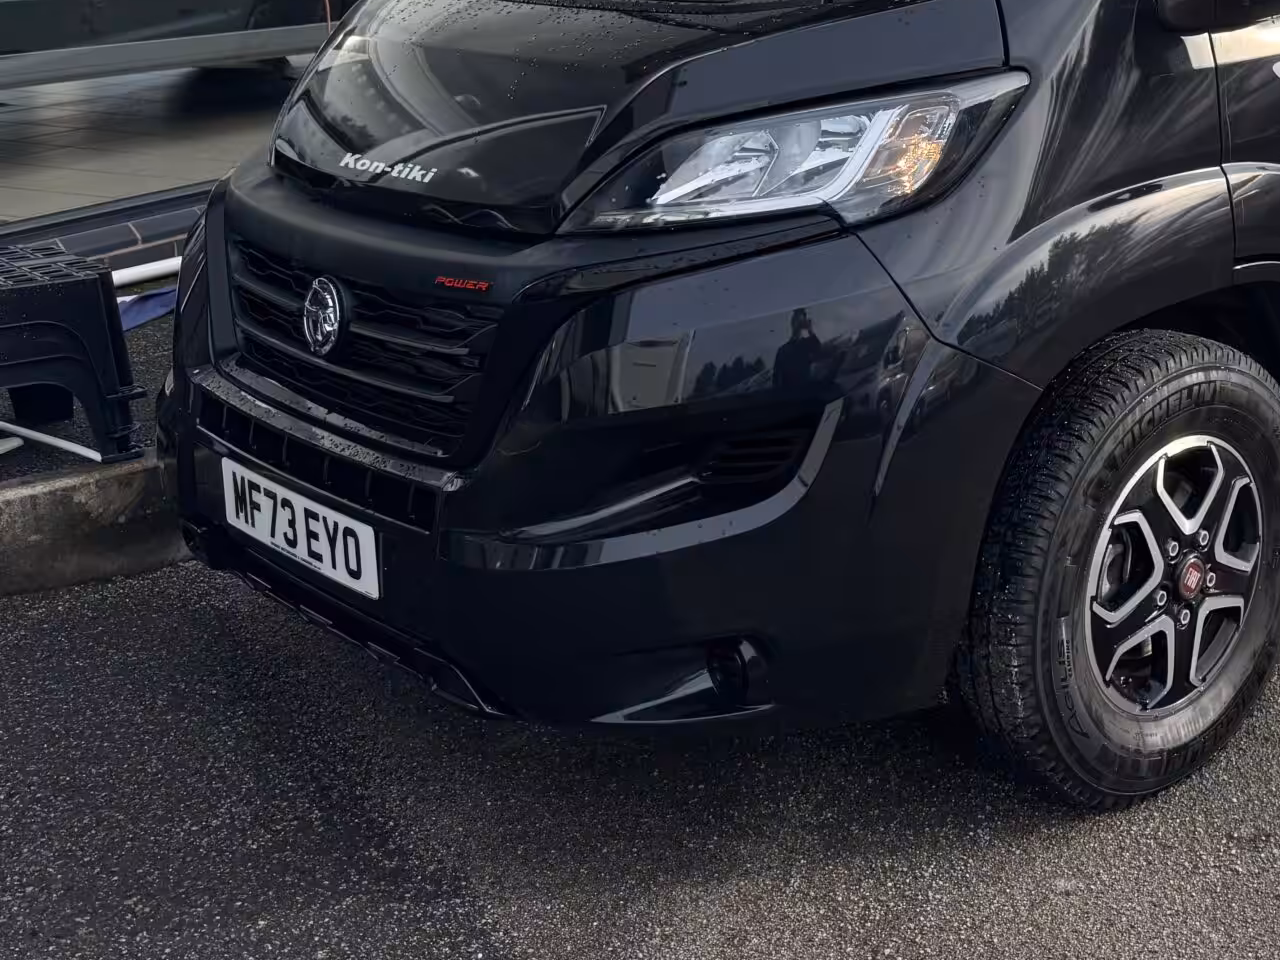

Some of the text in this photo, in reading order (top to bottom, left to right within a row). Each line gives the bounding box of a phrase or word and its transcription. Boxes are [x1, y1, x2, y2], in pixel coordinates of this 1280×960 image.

[338, 152, 438, 184] Kon-tiki
[434, 275, 489, 291] POWER
[232, 470, 363, 582] MF73 EYO
